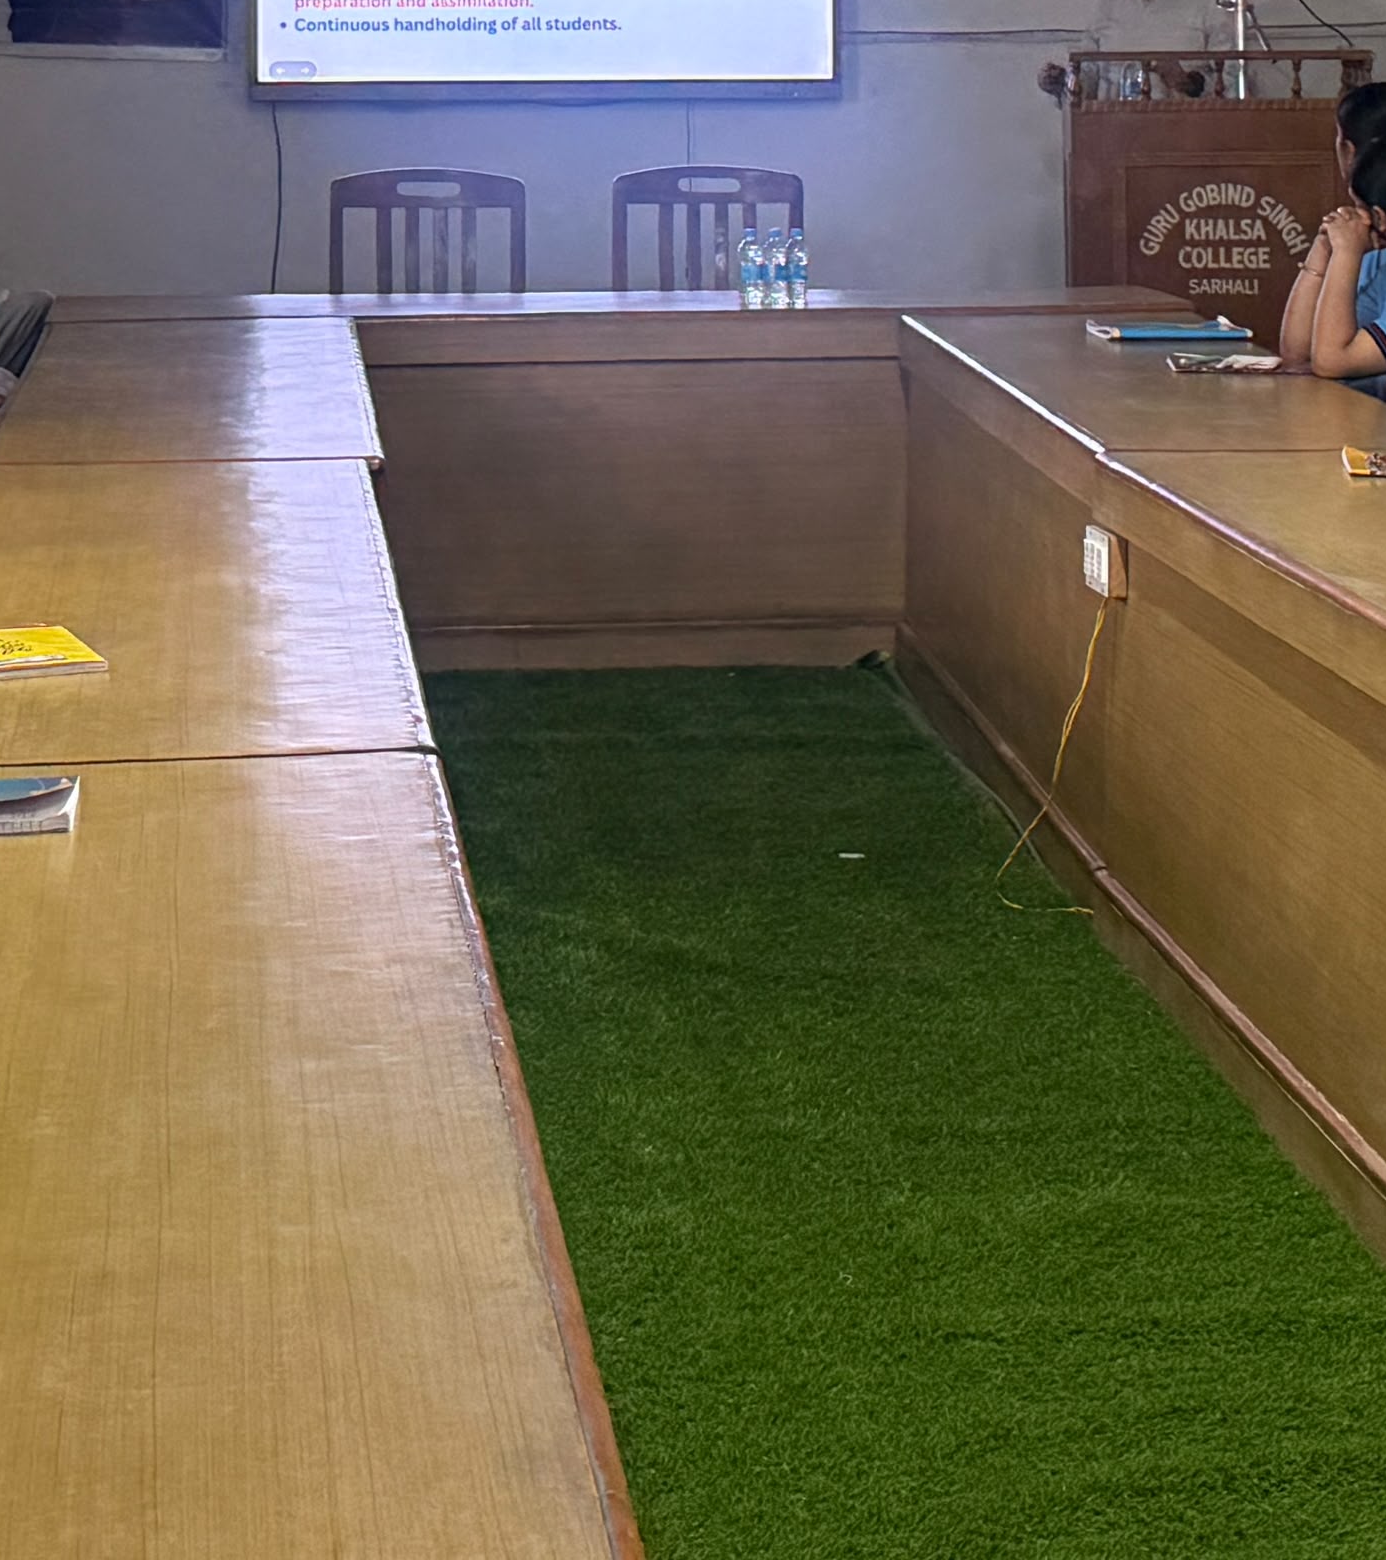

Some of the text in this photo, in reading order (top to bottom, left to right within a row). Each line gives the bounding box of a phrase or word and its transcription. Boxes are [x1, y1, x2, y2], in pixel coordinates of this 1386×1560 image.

[293, 16, 622, 36] Continuous handholding of all students.
[1139, 183, 1311, 256] GURU GOBIND SINGH
[1184, 218, 1267, 241] KHALSA
[1178, 245, 1271, 270] COLLEGE
[1188, 278, 1259, 296] SARHALI
